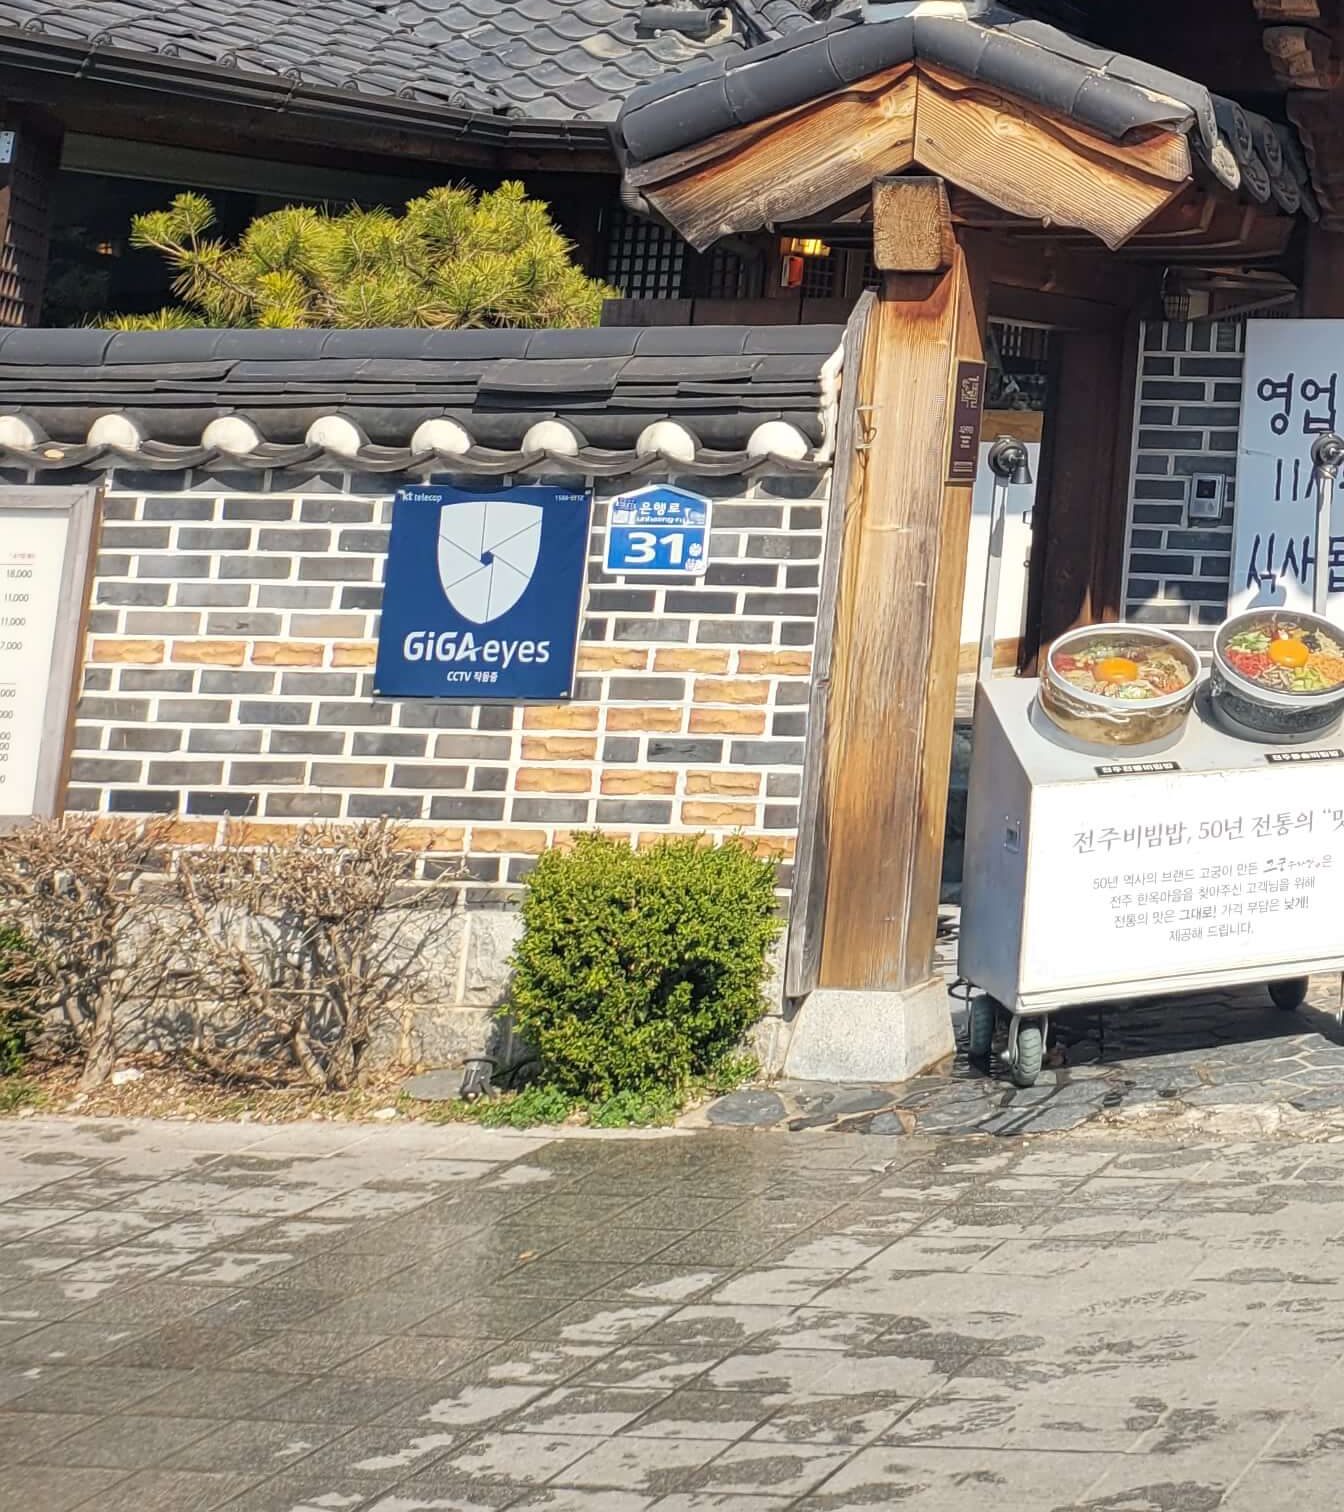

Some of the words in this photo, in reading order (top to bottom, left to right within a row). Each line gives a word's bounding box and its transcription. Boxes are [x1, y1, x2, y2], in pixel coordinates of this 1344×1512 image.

[1257, 372, 1337, 435] 영업
[639, 502, 680, 515] 은행로
[624, 531, 684, 564] 31
[447, 671, 471, 682] CCTV
[1072, 821, 1191, 854] 전주비빔밥,
[1198, 816, 1242, 841] 50년
[1252, 810, 1313, 838] 전통의
[1093, 876, 1118, 890] 50년
[1123, 872, 1157, 886] 역사의
[1162, 868, 1195, 883] 브랜드
[1200, 865, 1233, 879] 고궁이
[1236, 862, 1258, 876] 만든
[1110, 894, 1133, 908] 전주
[1137, 888, 1193, 906] 한옥마을을
[1198, 884, 1242, 899] 찾아주신
[1247, 879, 1290, 894] 고객님을
[1295, 876, 1316, 889] 위해
[1114, 913, 1148, 929] 전통의
[1152, 910, 1175, 924] 맛은
[1178, 906, 1217, 921] 그대로!
[1222, 902, 1243, 916] 가격
[1247, 899, 1280, 915] 부담은
[1169, 927, 1203, 943] 제공해
[1207, 921, 1254, 938] 드립니다.
